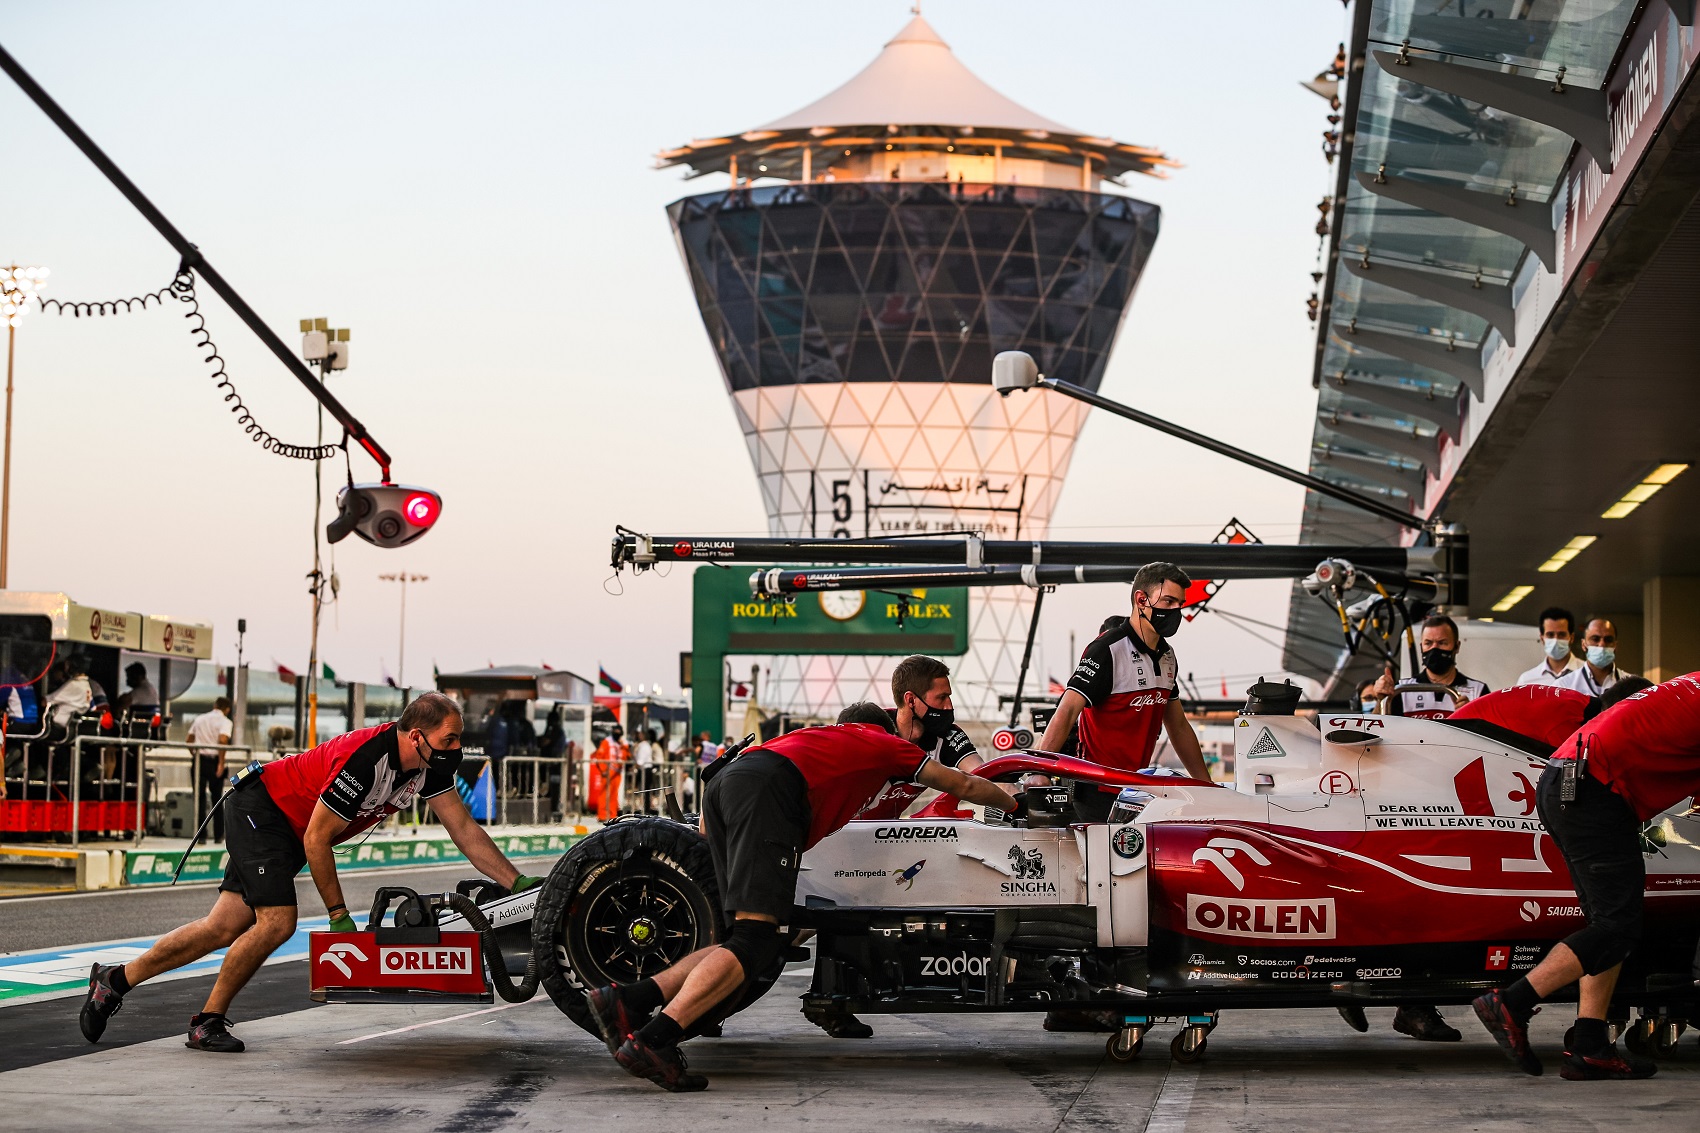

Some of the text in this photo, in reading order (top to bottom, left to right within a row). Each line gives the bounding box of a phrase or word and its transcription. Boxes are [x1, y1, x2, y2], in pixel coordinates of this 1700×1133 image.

[692, 541, 735, 549] URALKALI
[733, 603, 798, 618] ROLEX
[1378, 804, 1455, 813] DEAR KIMI
[1376, 818, 1398, 828] WE
[1401, 817, 1436, 827] WILL
[1440, 818, 1485, 828] LEAVE
[1487, 819, 1516, 829] YOU
[874, 826, 959, 840] CARRERA
[834, 868, 887, 879] #PanTorpeda
[1000, 881, 1057, 893] SINGHA
[499, 901, 536, 921] Additive
[1195, 902, 1327, 934] ORLEN
[1514, 945, 1541, 953] Schweiz
[385, 951, 466, 971] ORLEN
[920, 950, 991, 976] zadar
[1355, 967, 1402, 980] sparco
